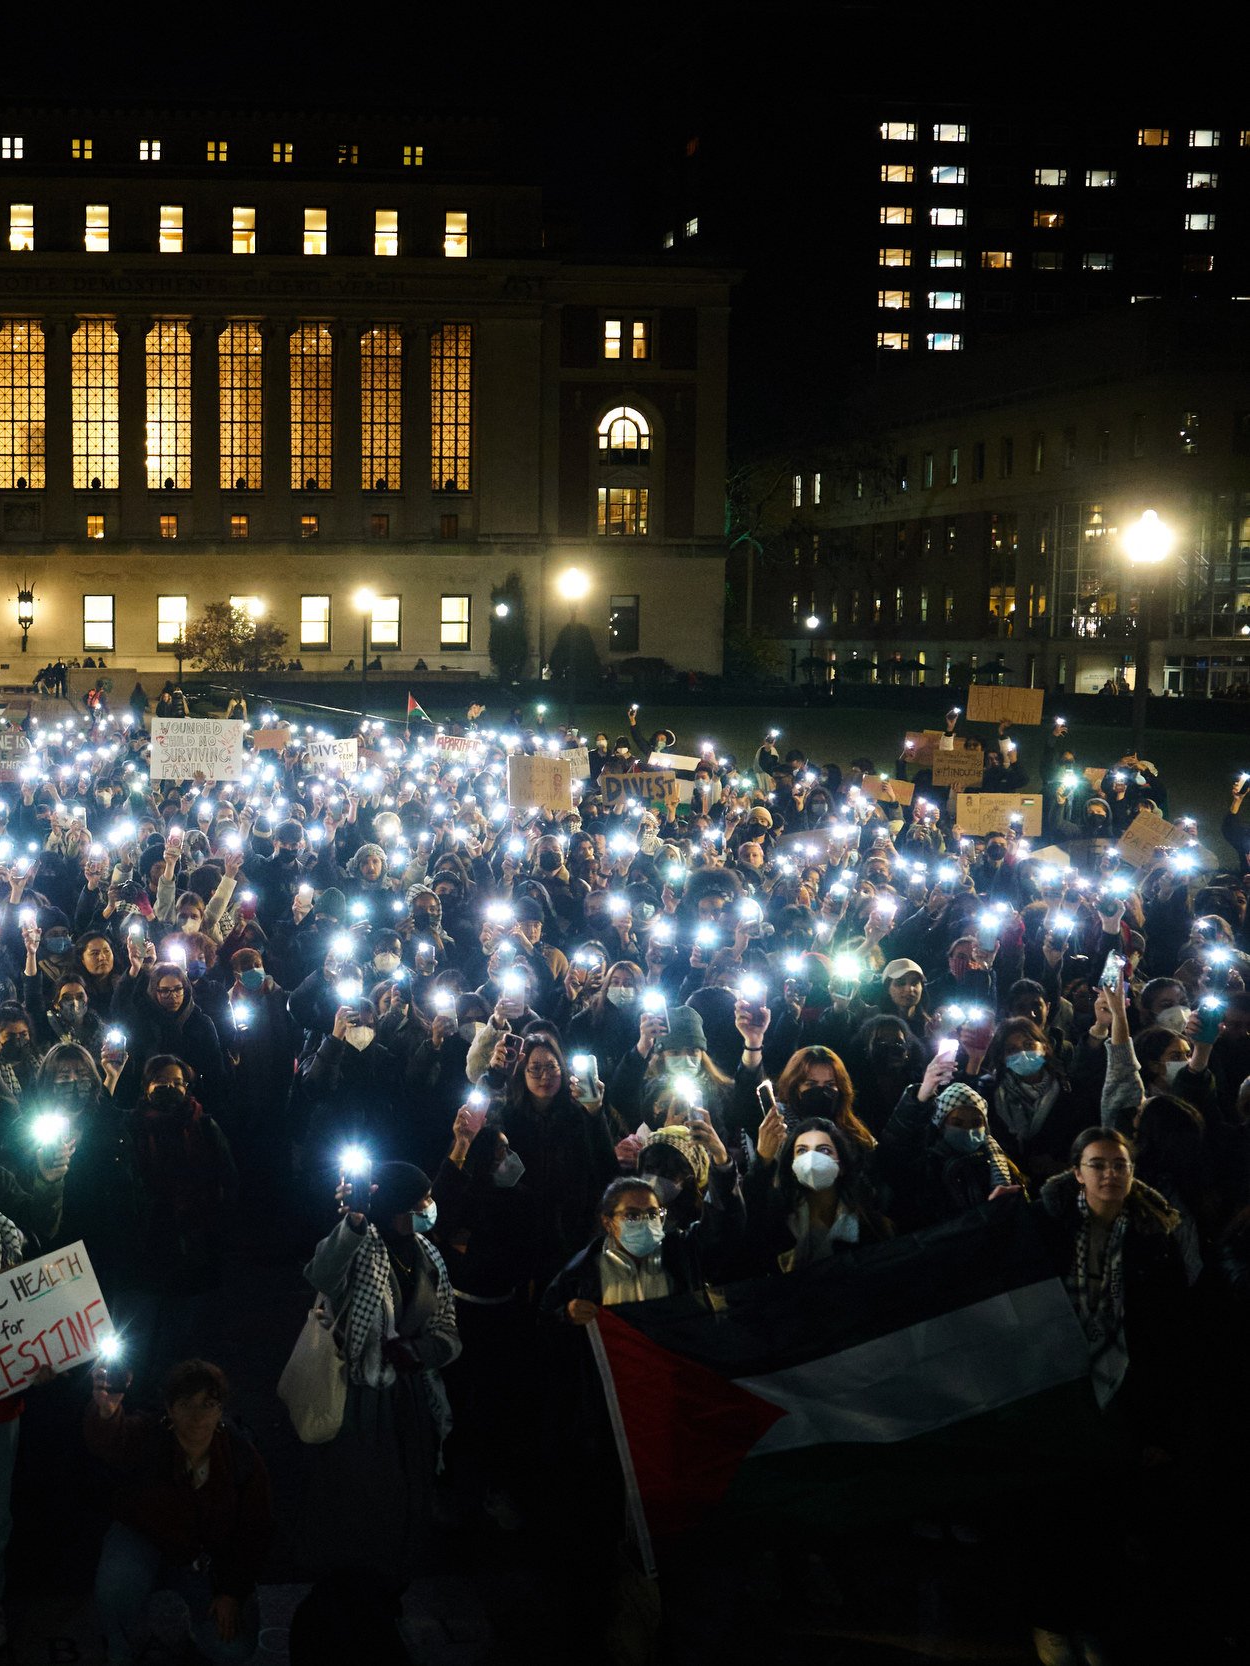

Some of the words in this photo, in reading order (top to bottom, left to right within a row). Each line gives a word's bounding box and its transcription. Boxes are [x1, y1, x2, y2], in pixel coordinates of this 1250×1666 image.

[160, 721, 223, 736] WOUNDED
[16, 735, 27, 750] IS
[198, 735, 217, 747] NO
[311, 741, 351, 757] DIVEST
[160, 747, 231, 763] SURVIVING
[606, 776, 676, 802] DIVEST
[10, 1252, 84, 1302] HEALTH
[1, 1318, 25, 1341] for
